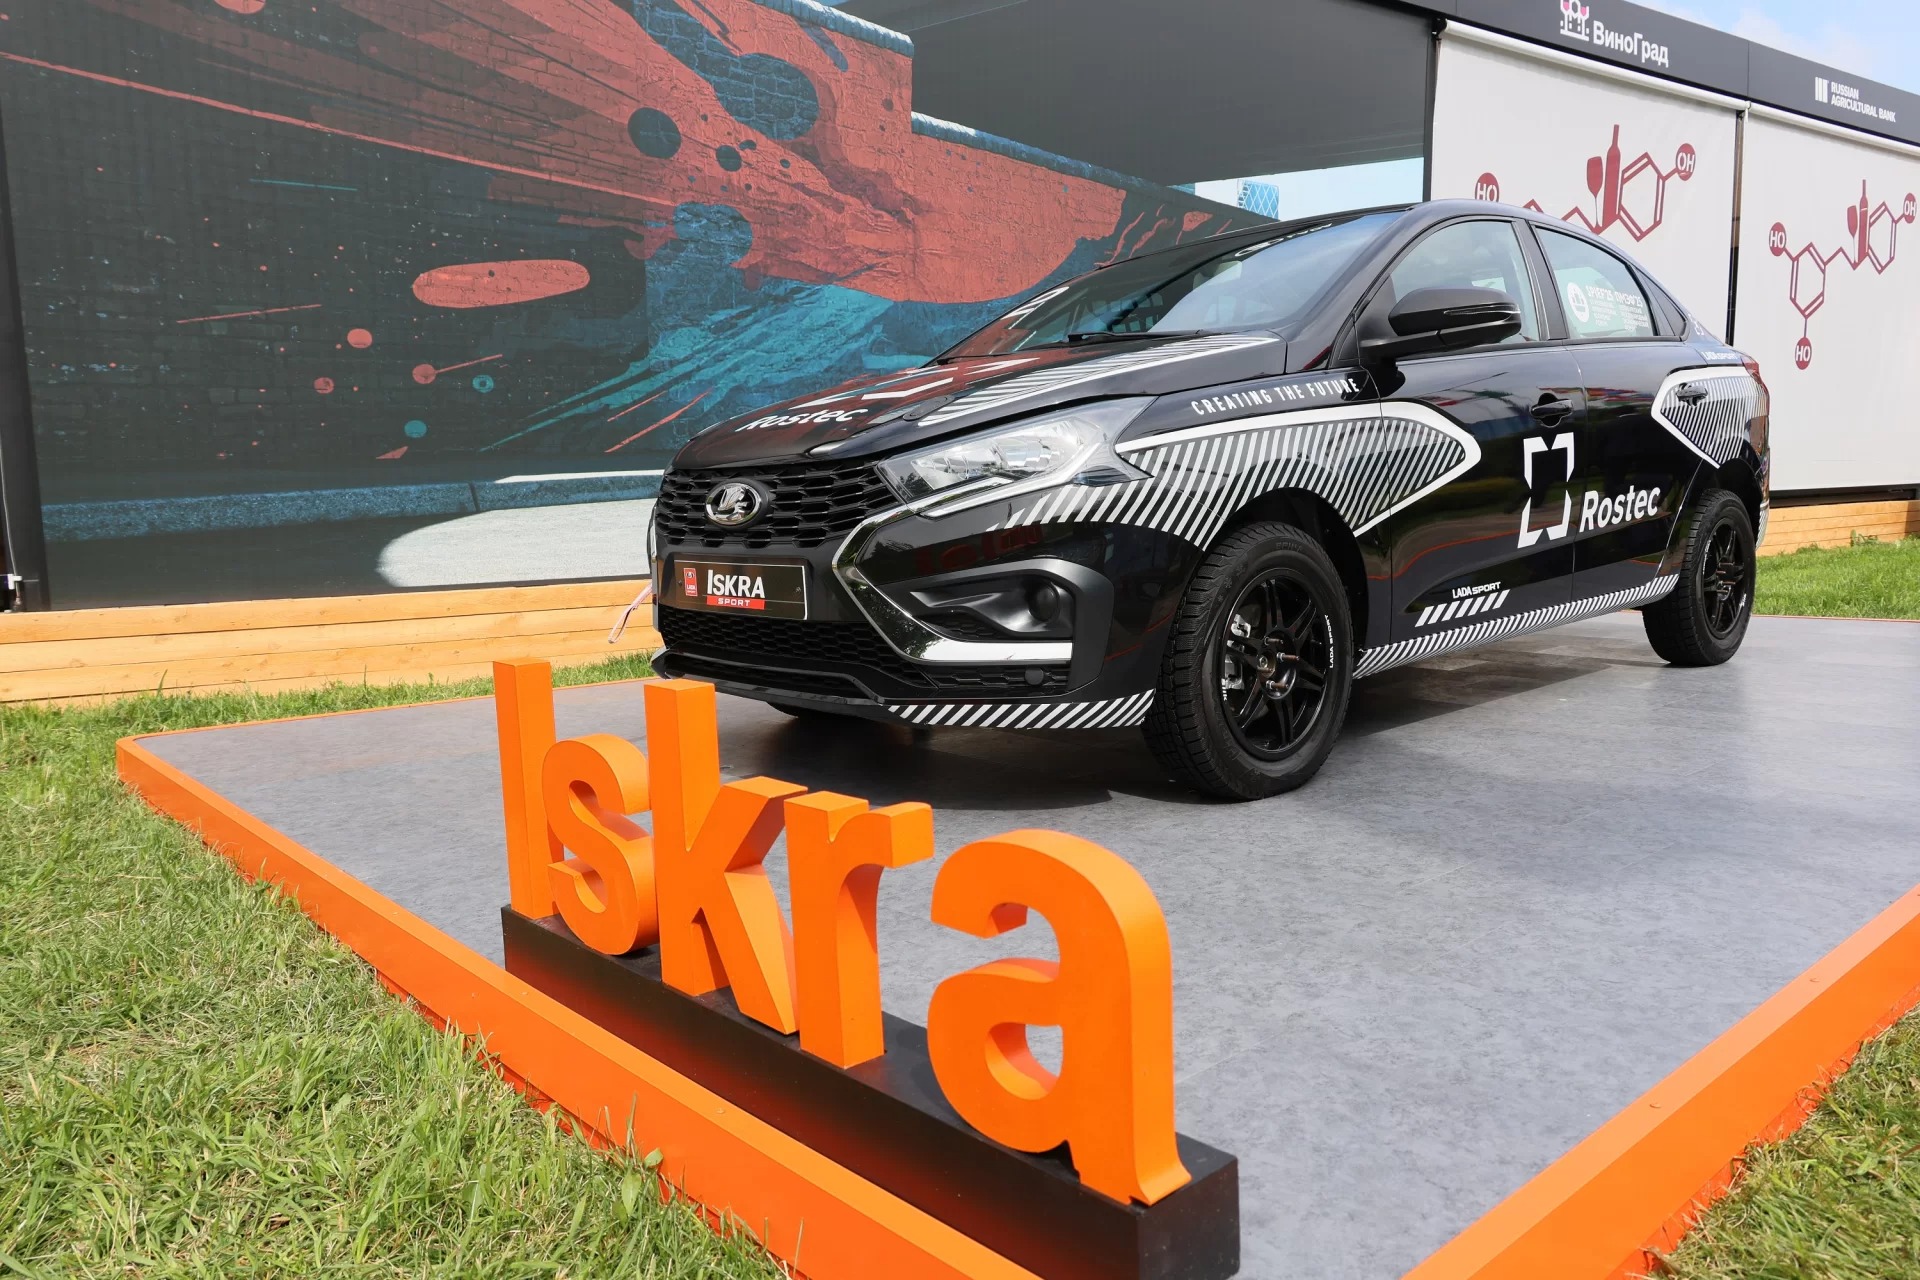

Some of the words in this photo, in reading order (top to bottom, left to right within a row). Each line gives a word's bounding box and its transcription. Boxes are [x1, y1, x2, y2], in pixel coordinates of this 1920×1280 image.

[1593, 20, 1669, 68] ВиноГрад
[1831, 81, 1859, 100] RUSSIAN
[1831, 94, 1878, 118] AGRICULTURAL
[1878, 107, 1896, 122] BANK
[1677, 152, 1695, 173] OH
[1476, 183, 1498, 201] HO
[1903, 200, 1917, 217] OH
[1769, 230, 1785, 248] HO
[1795, 345, 1811, 362] HO
[1191, 389, 1273, 415] CREATING
[1273, 384, 1305, 401] THE
[1306, 378, 1360, 397] FUTURE
[735, 408, 869, 432] Rostec
[1578, 484, 1661, 534] Rostec
[707, 569, 766, 599] ISKRA
[1452, 586, 1473, 599] LADA
[1472, 581, 1502, 595] SPORT
[717, 598, 751, 607] SPORT
[1324, 614, 1333, 645] SPORT
[493, 657, 1191, 1206] Iskra
